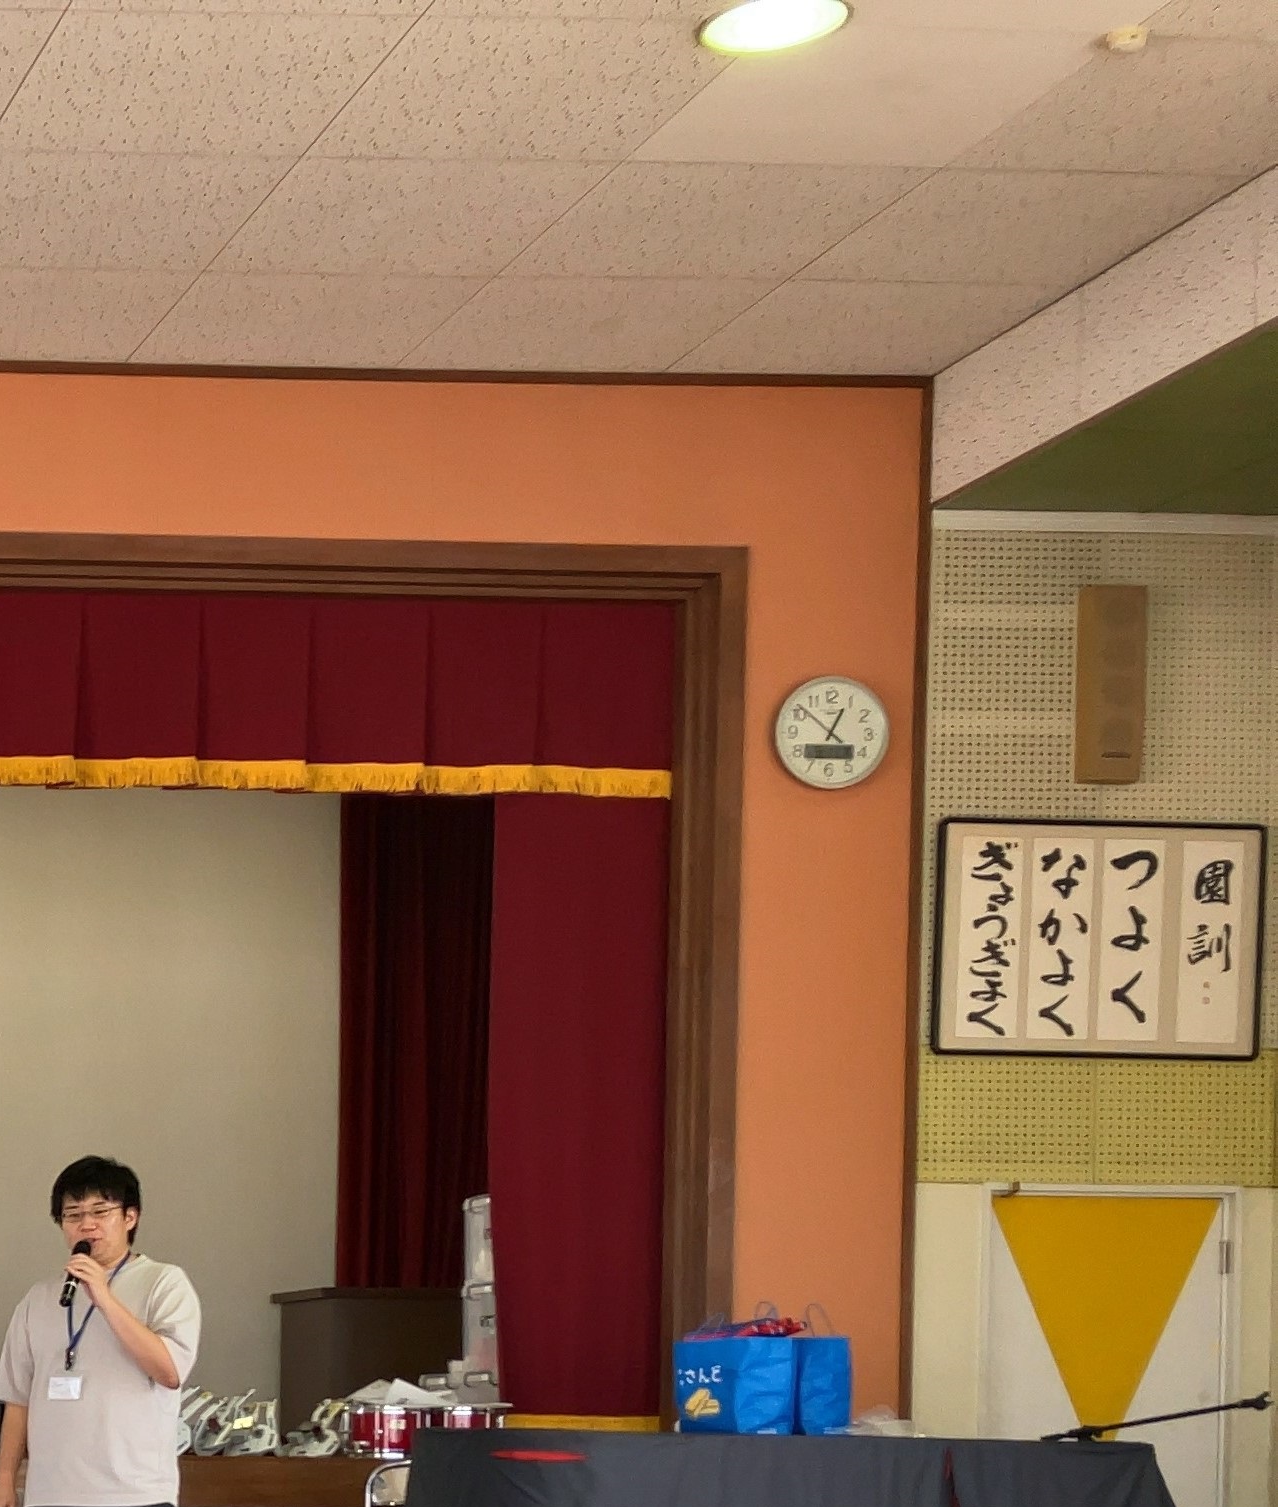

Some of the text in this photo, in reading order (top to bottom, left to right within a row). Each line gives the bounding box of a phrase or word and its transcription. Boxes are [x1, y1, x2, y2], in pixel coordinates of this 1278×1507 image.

[809, 695, 819, 708] 11
[826, 689, 840, 704] 12
[849, 695, 854, 708] 1
[859, 709, 871, 723] 2
[788, 725, 798, 739] 9
[864, 728, 874, 741] 3
[793, 745, 803, 757] 8
[857, 746, 867, 757] 4
[824, 763, 834, 776] 6
[844, 760, 853, 772] 5
[1187, 859, 1234, 972] 園訓
[967, 841, 1018, 1035] ぎょうぎよく
[1038, 848, 1088, 1036] なかよく
[1110, 850, 1158, 1023] つよく
